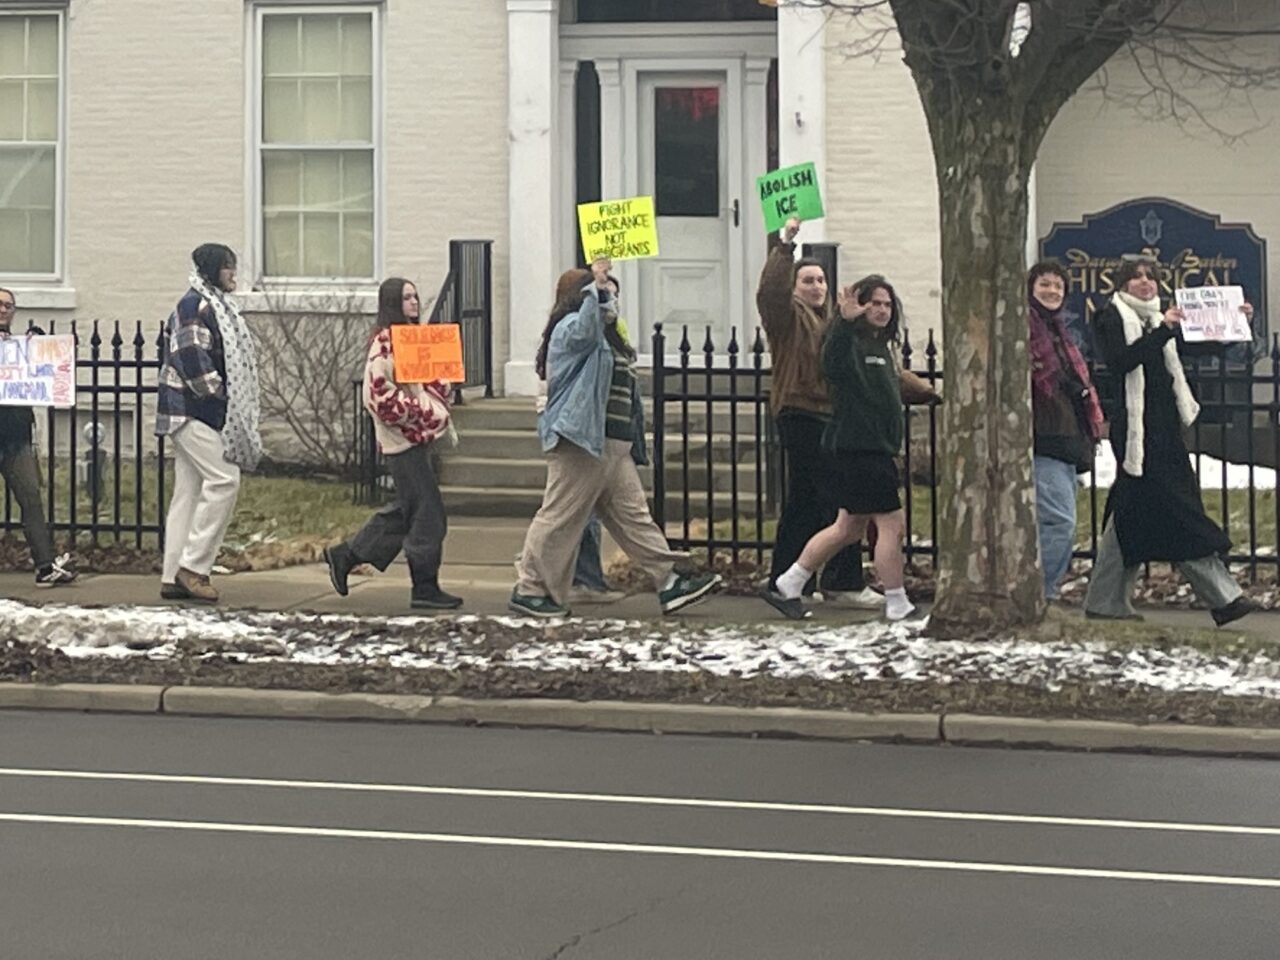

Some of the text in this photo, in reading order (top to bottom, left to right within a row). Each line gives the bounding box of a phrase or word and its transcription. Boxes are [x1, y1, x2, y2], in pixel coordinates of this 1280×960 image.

[761, 169, 813, 200] ABOLISH
[599, 201, 632, 217] FIGHT
[776, 193, 798, 218] ICE
[587, 214, 650, 235] IGNORANCE
[605, 231, 627, 245] NOT
